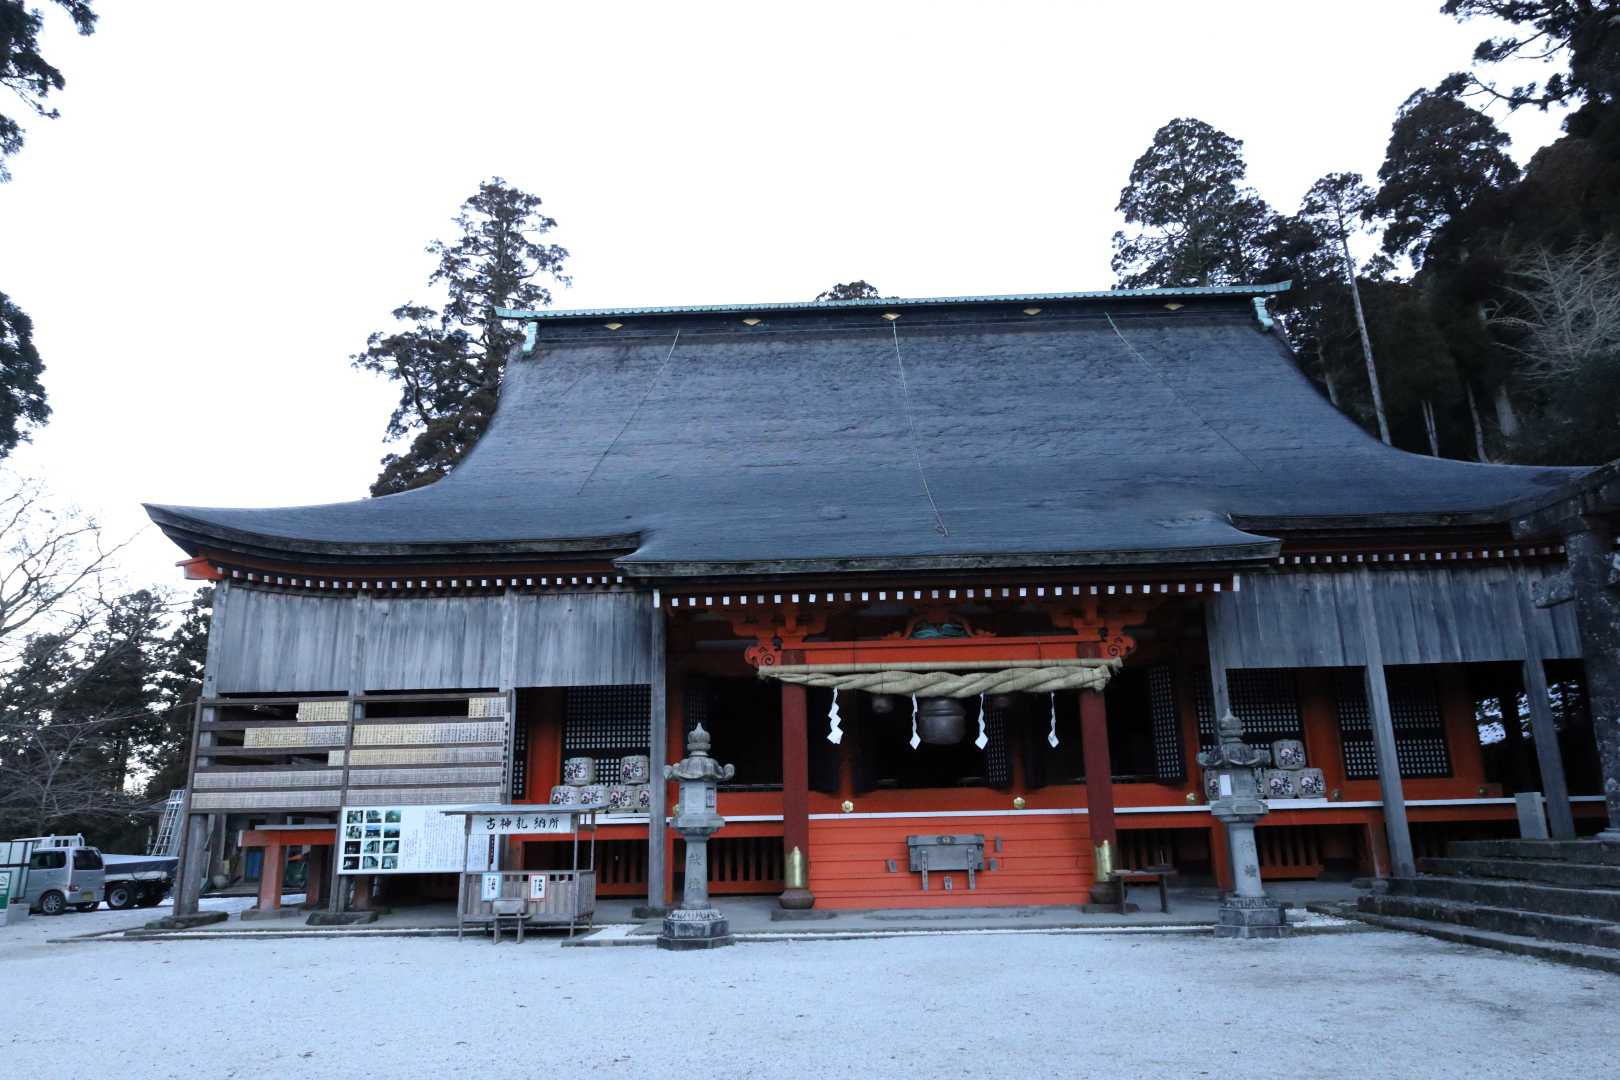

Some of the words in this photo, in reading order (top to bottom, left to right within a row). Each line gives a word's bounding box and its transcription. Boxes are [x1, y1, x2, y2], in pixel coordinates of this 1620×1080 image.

[486, 816, 560, 830] 古神札納所
